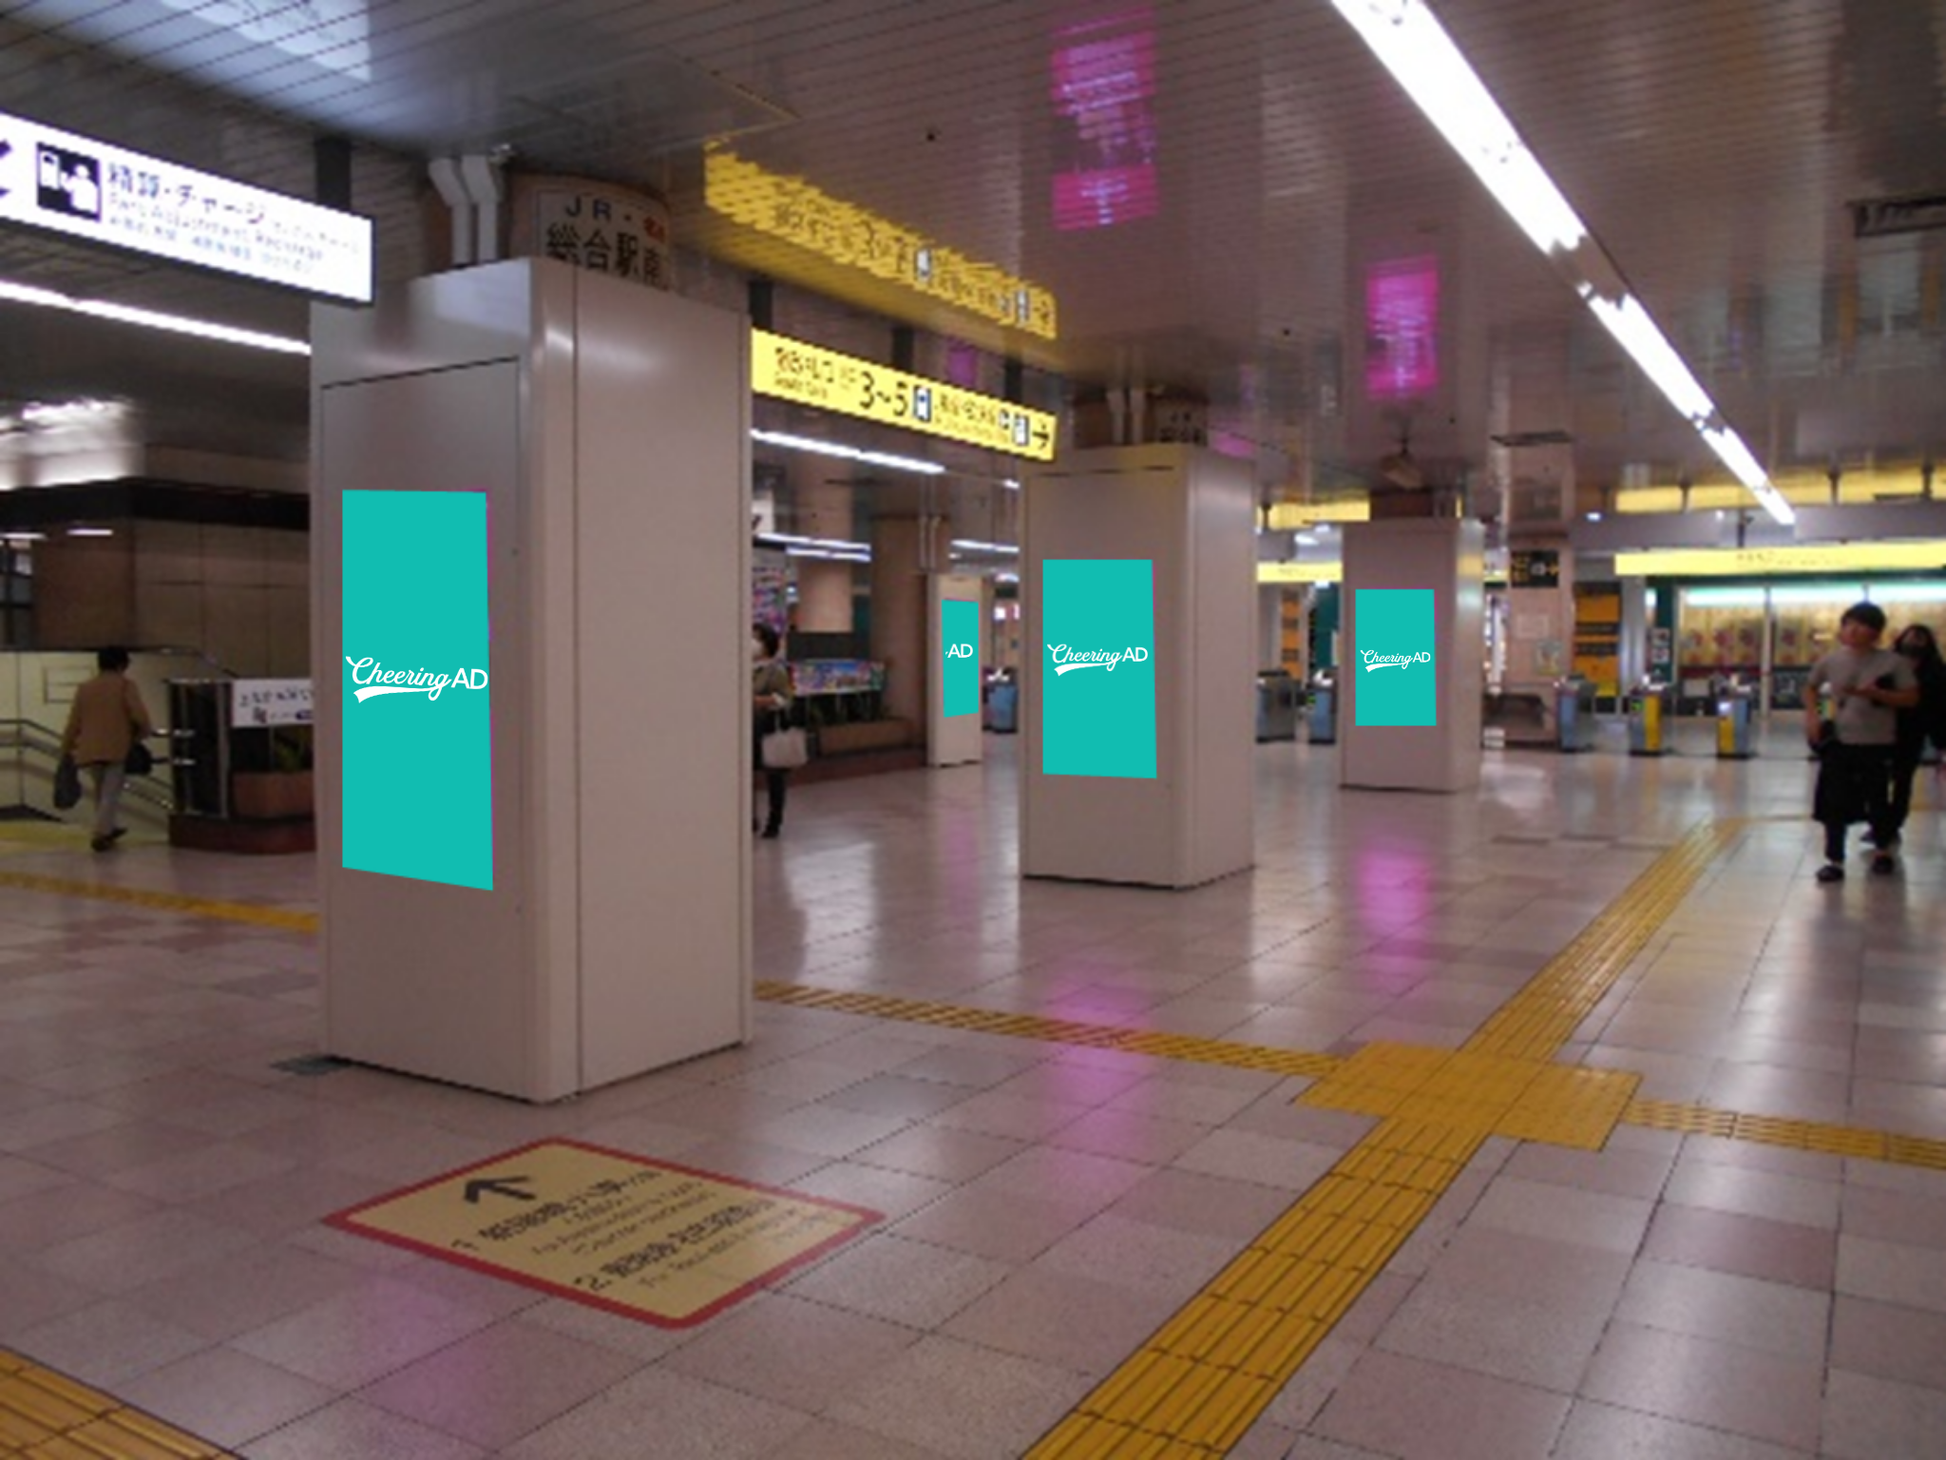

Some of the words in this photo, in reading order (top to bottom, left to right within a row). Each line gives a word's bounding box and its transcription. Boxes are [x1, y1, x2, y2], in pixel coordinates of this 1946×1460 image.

[947, 643, 974, 658] AD
[1047, 644, 1123, 676] Cheering
[1122, 647, 1149, 662] AD
[1360, 649, 1413, 673] Cheering
[1412, 651, 1431, 663] AD
[345, 656, 452, 703] Cheering
[450, 667, 489, 690] AD
